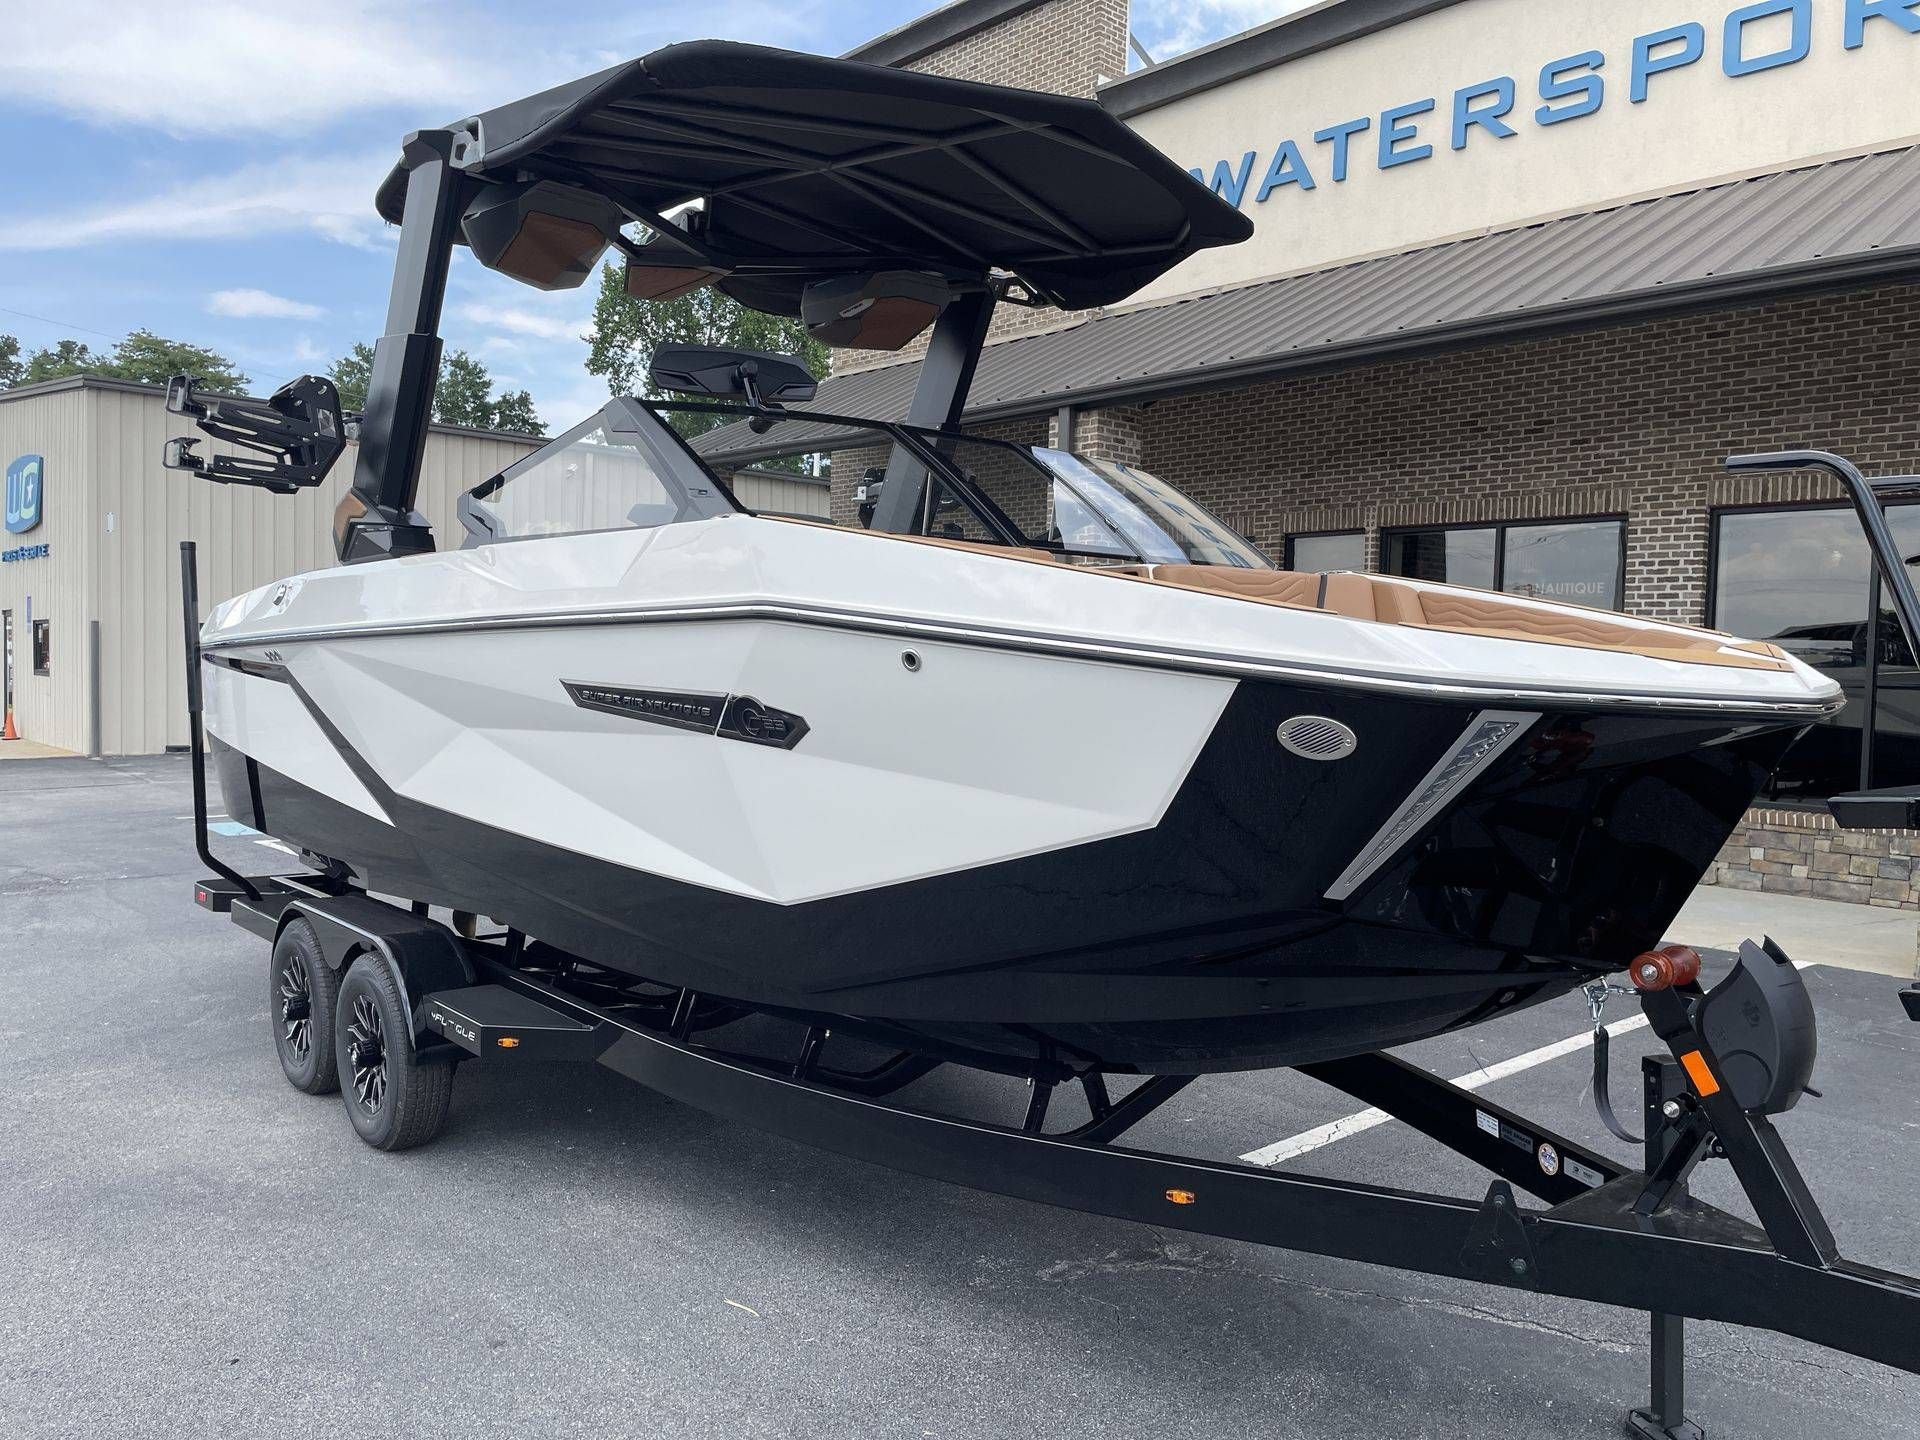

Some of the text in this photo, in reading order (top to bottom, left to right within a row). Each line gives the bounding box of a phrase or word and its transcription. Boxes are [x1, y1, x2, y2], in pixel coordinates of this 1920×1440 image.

[1535, 581, 1605, 595] NAUTIQUE
[581, 689, 712, 717] SUPER AIR NAUTIQUE
[430, 1011, 476, 1042] NAUTQUE
